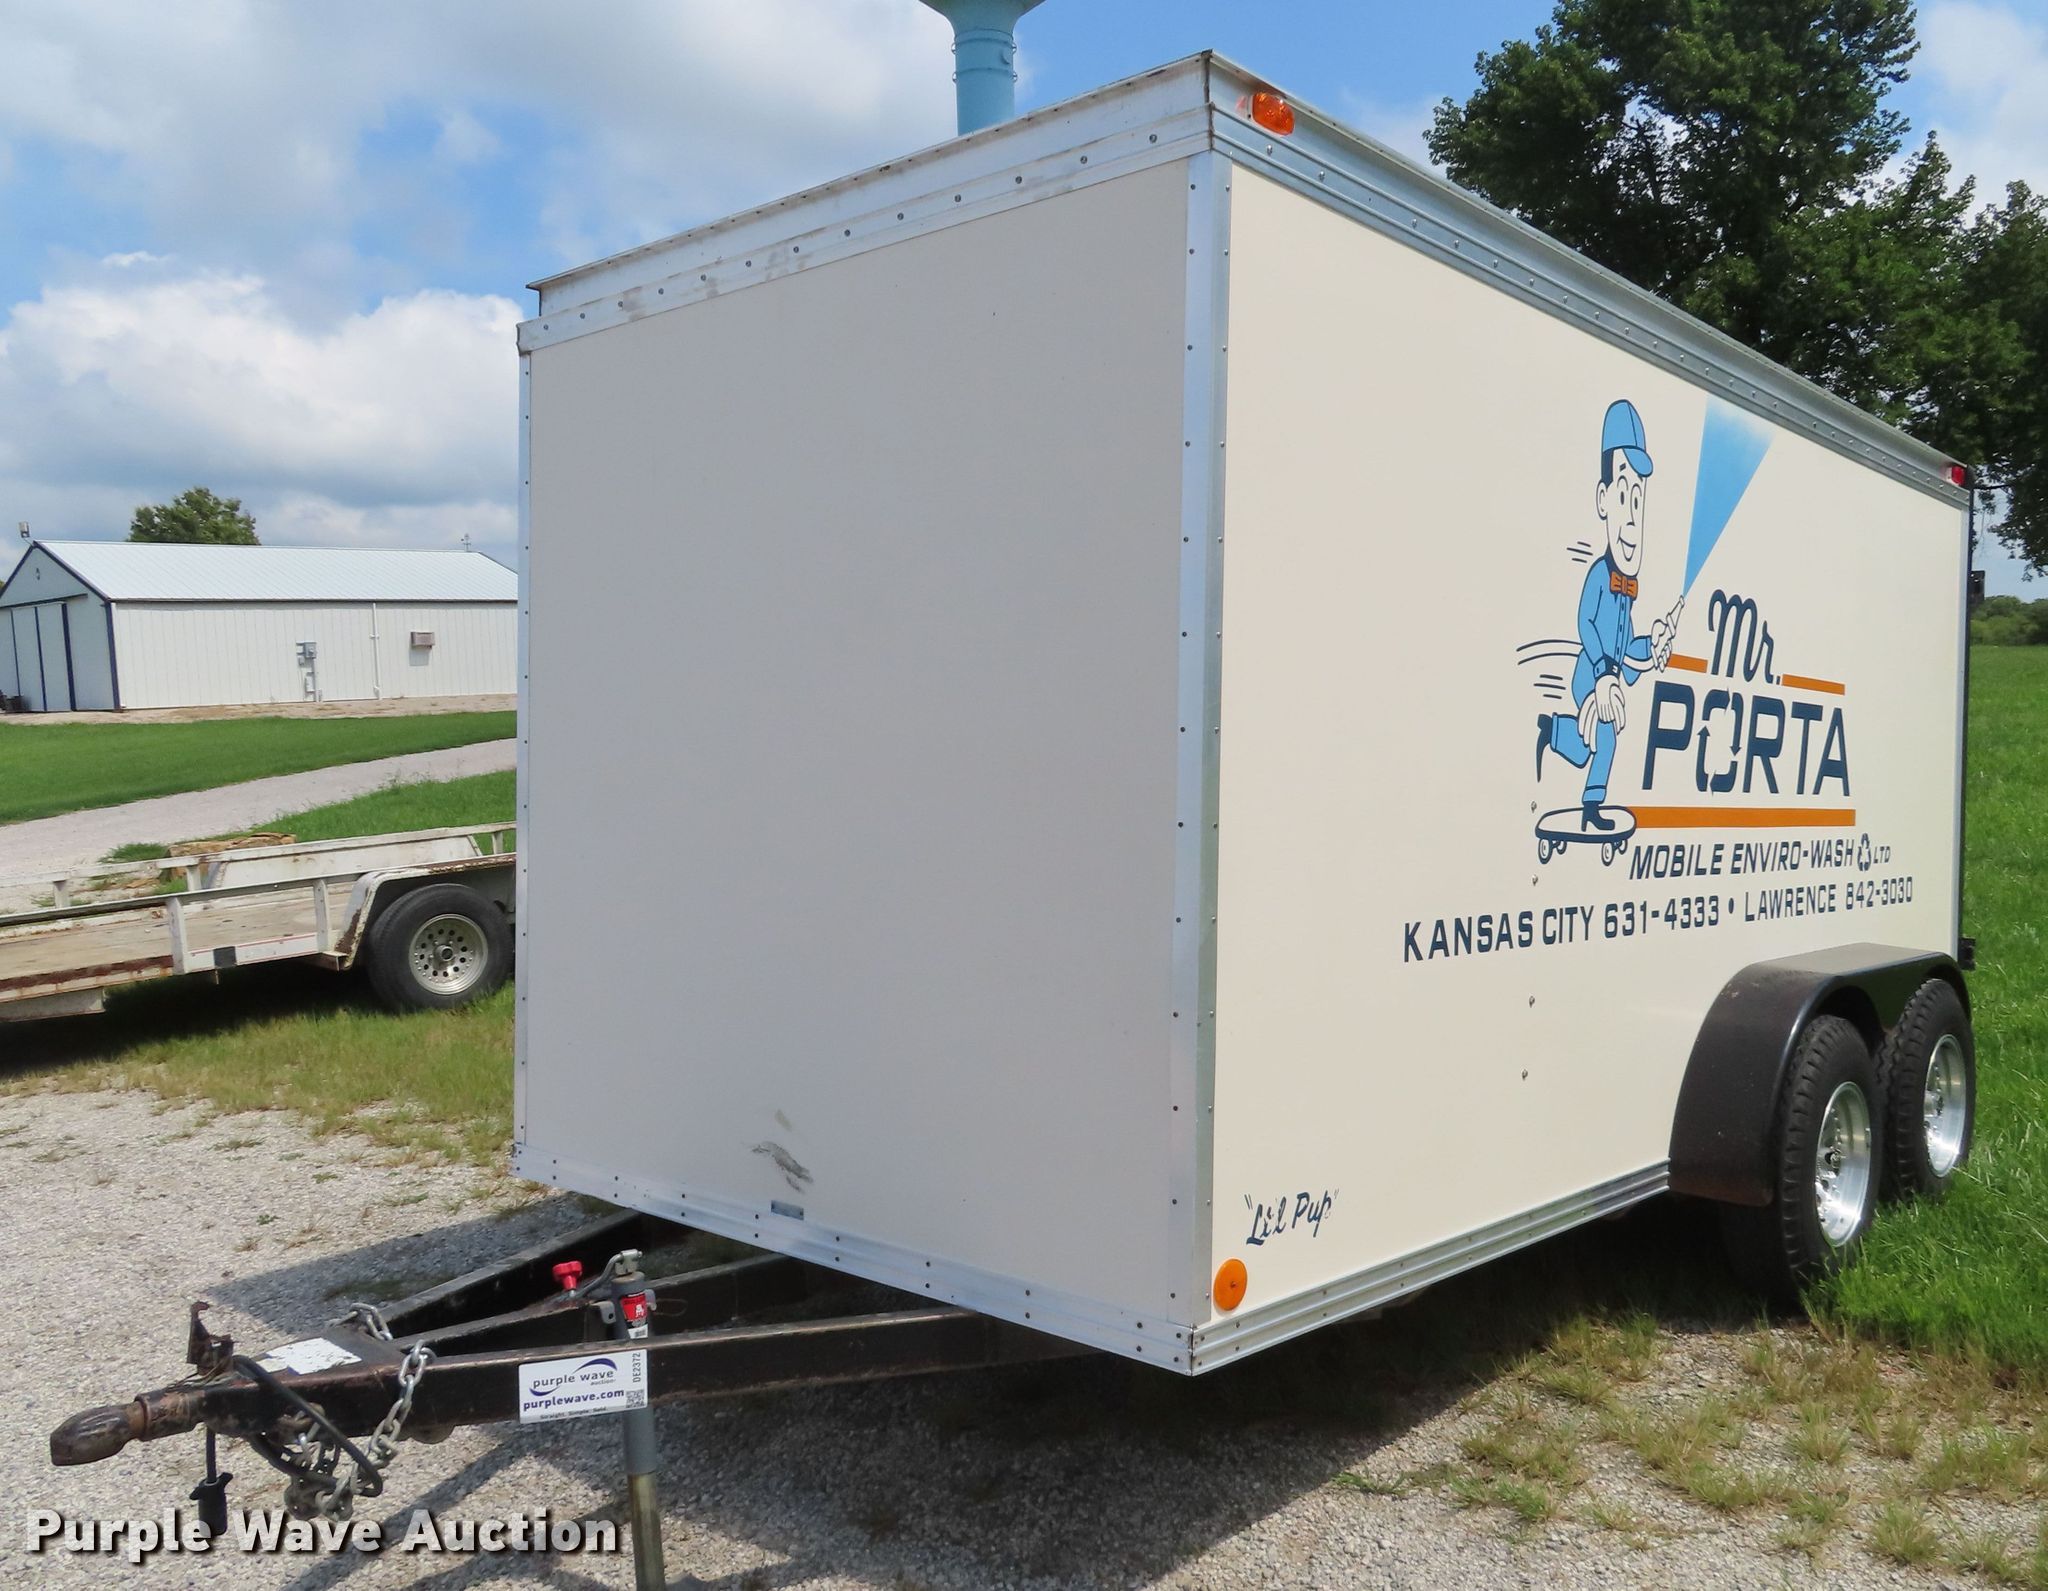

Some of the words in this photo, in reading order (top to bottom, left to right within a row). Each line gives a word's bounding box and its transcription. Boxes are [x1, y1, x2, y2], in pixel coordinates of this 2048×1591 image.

[1707, 588, 1782, 686] Mr.
[1641, 680, 1850, 797] PORTA
[1628, 843, 1725, 880] MOBILE
[1730, 838, 1855, 875] ENVIRO-WASH
[1873, 845, 1891, 864] LTD
[1403, 910, 1533, 963] KANSAS
[1542, 905, 1594, 945] CITY
[1604, 895, 1719, 938] 631-4333
[1744, 883, 1836, 922] LAWRENCE
[1846, 876, 1913, 910] 842-3030
[533, 1374, 575, 1389] purple
[579, 1370, 614, 1382] wave
[632, 1353, 641, 1383] DE2372
[523, 1389, 625, 1411] purplewave.com
